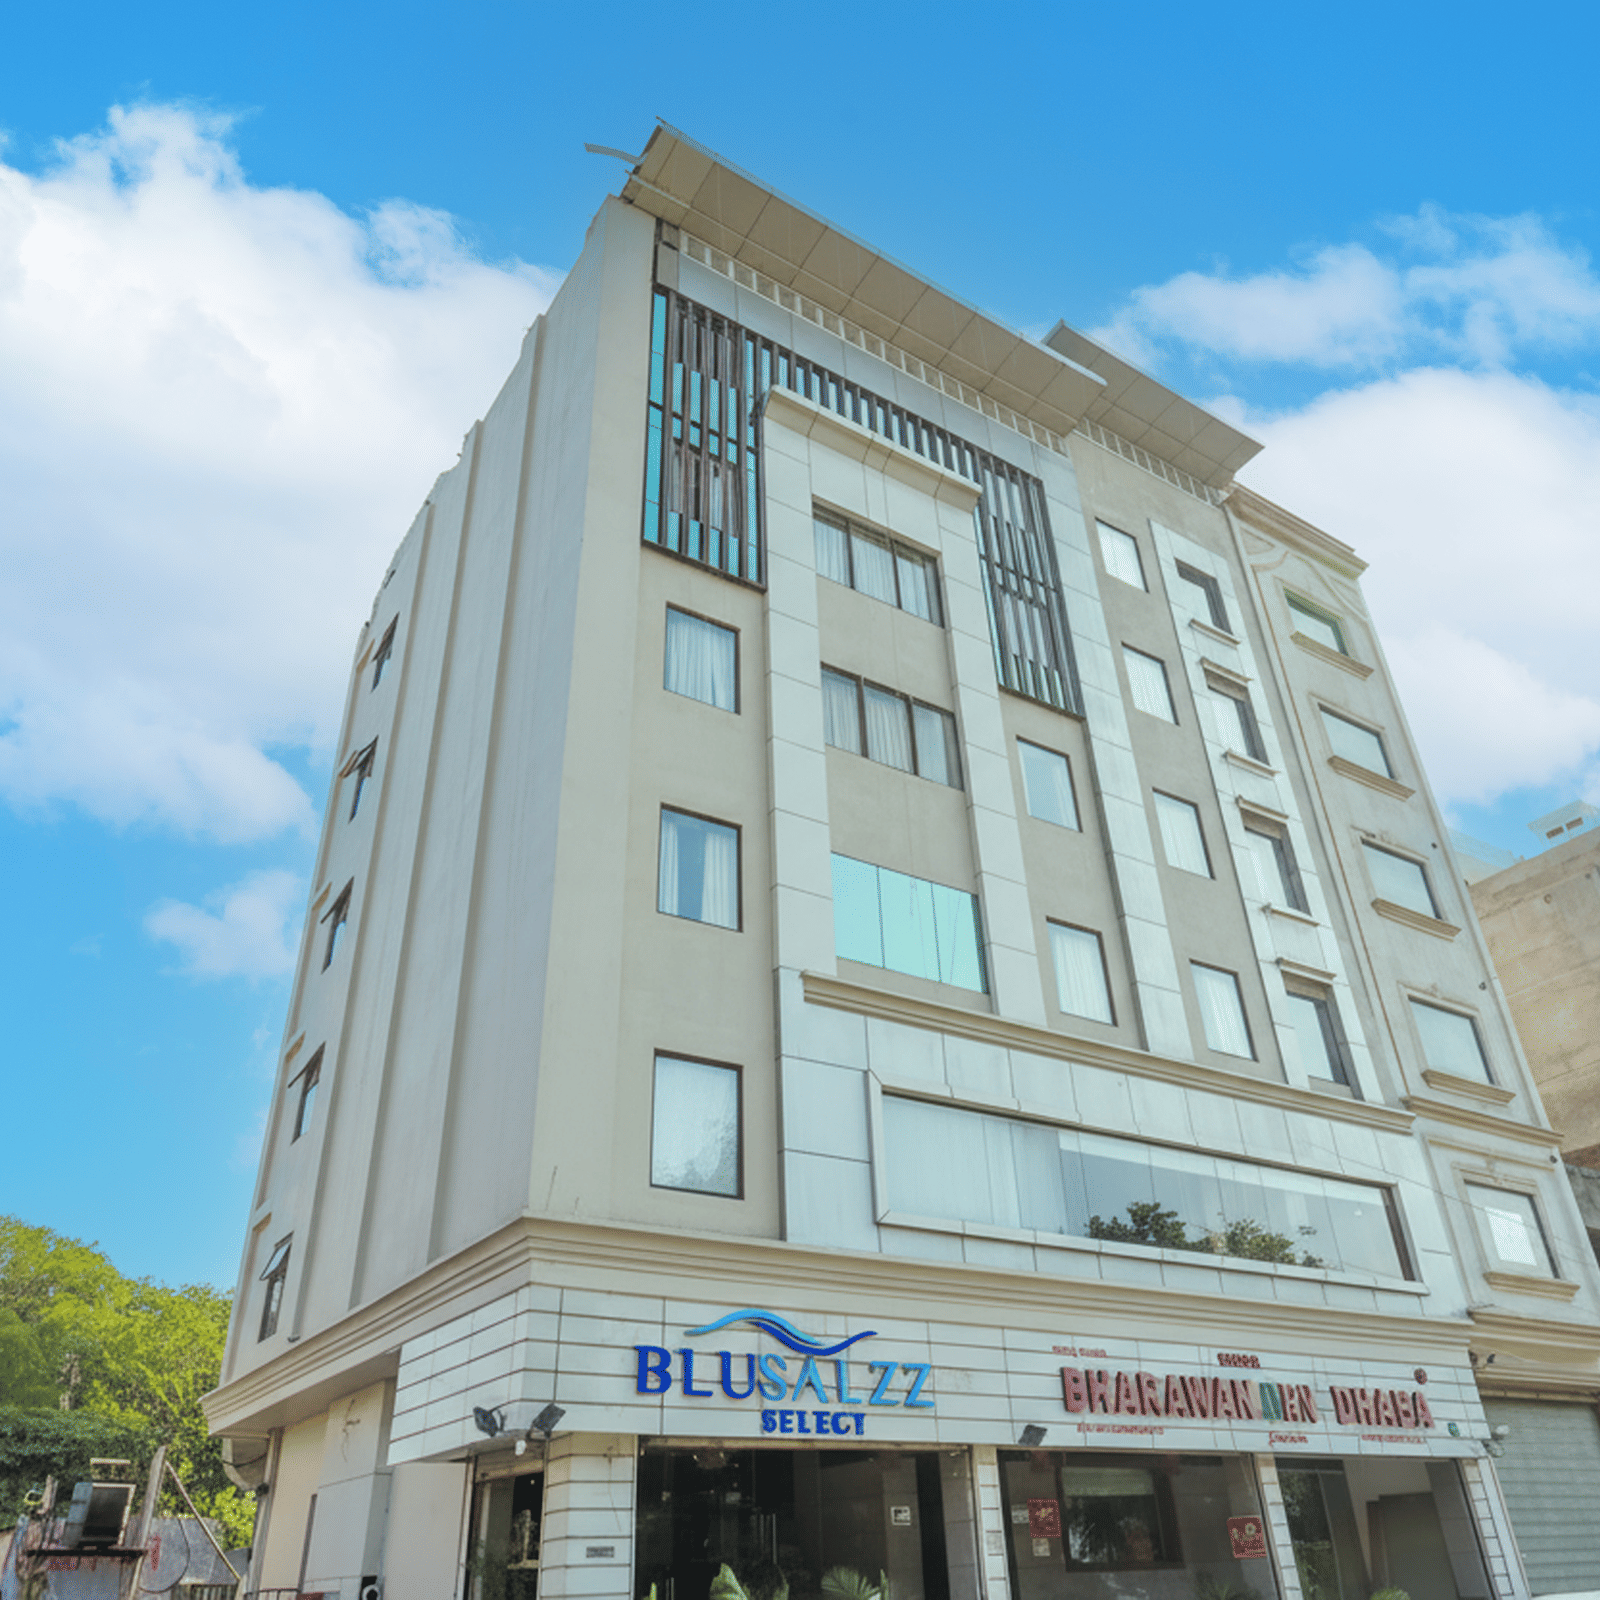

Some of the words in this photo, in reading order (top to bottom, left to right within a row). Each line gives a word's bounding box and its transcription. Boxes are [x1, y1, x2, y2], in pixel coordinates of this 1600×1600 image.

[634, 1344, 935, 1407] BLUSALZZ
[761, 1409, 866, 1436] SELECT
[1329, 1384, 1436, 1429] DHABA
